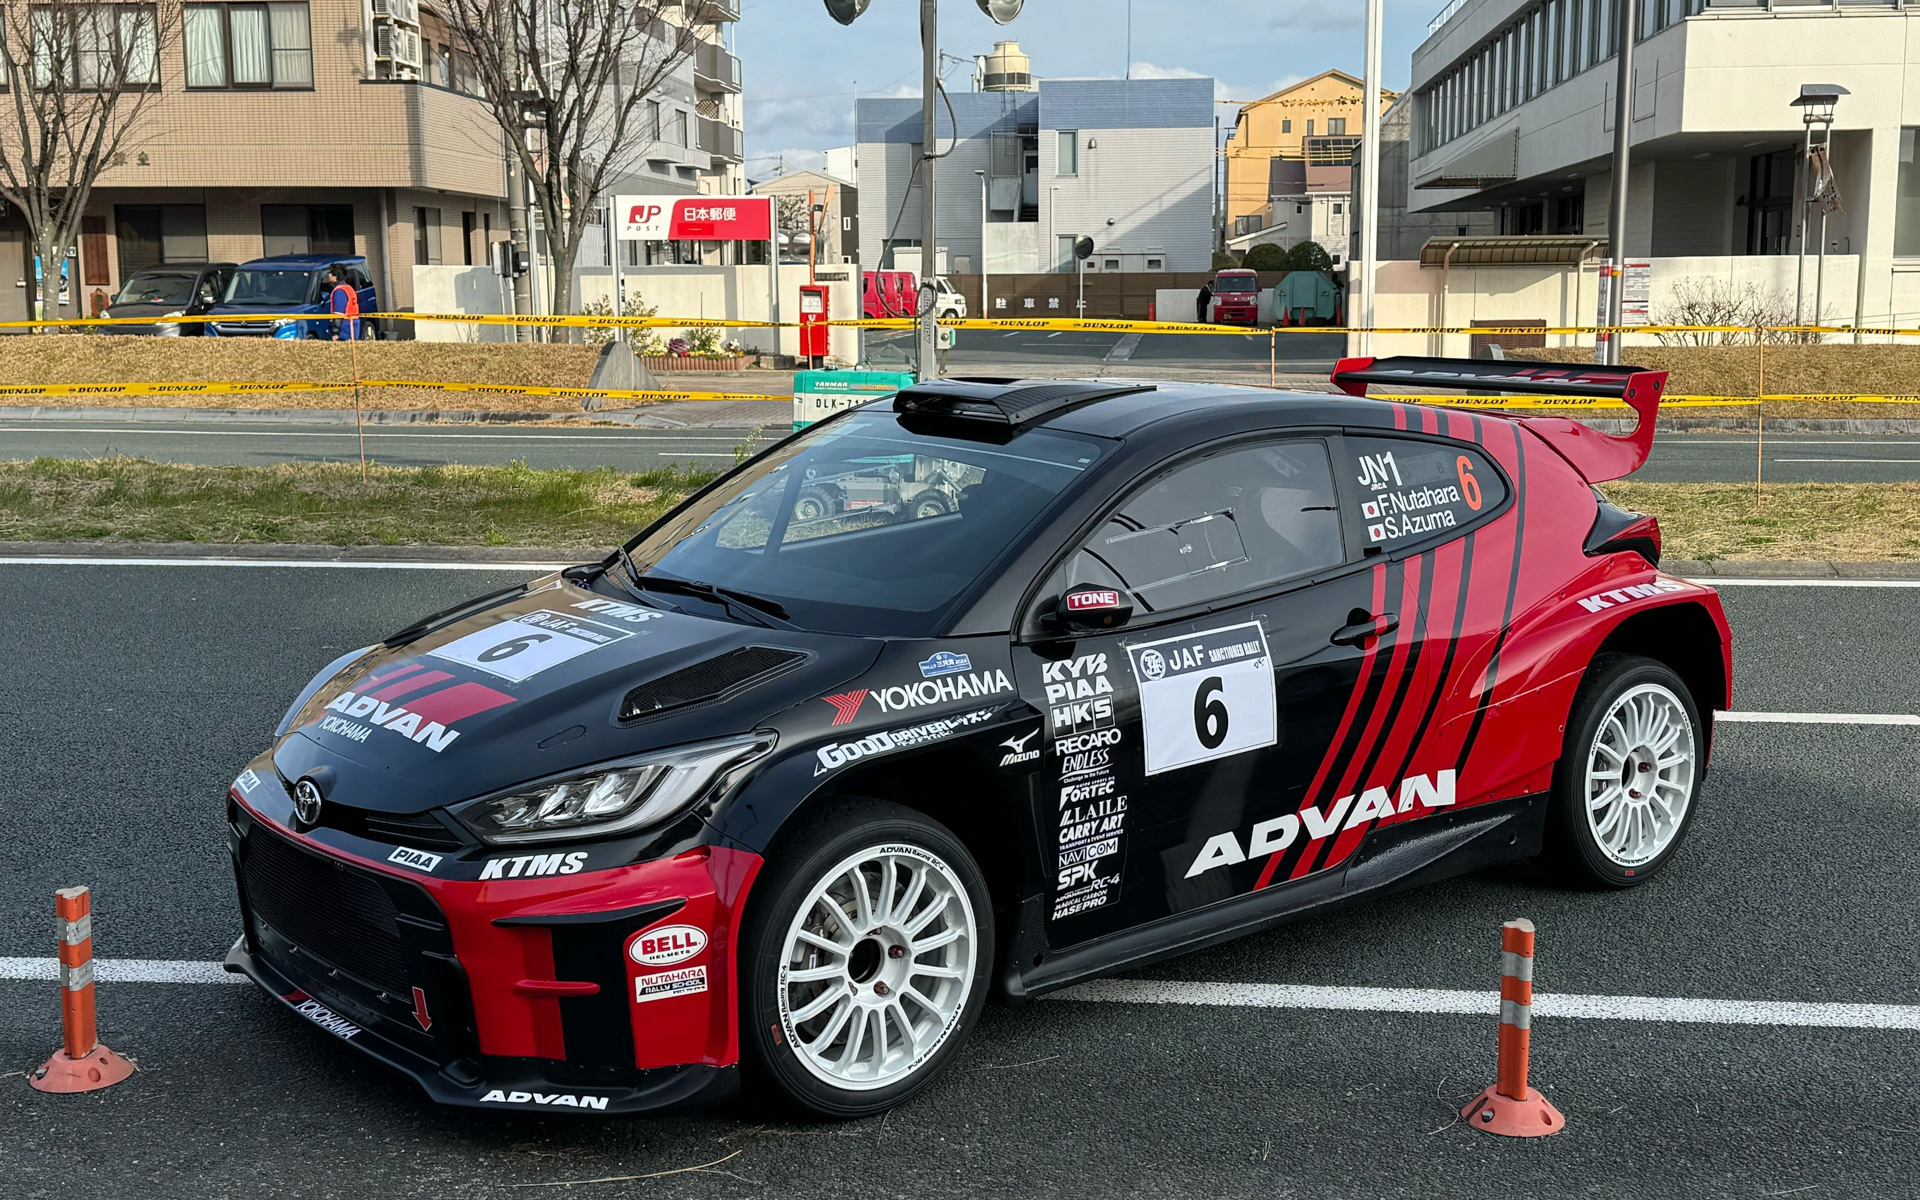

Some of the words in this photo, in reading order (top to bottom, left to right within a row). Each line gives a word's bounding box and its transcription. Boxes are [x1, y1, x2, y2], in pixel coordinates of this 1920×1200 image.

[629, 205, 662, 223] JP
[684, 207, 737, 222] 日本郵便
[996, 297, 1087, 309] 駐車禁止
[815, 381, 848, 389] YANMAR
[1357, 451, 1403, 487] JN1
[1456, 455, 1482, 511] 6
[1370, 482, 1388, 491] JRCA
[1377, 485, 1461, 516] F.Nutahara
[1384, 509, 1457, 539] S.Azuma
[569, 598, 664, 623] KTMS
[1071, 592, 1115, 607] TONE
[1577, 580, 1685, 613] KTMS
[539, 618, 579, 630] JAF
[477, 633, 553, 663] 6
[1169, 644, 1204, 671] JAF
[1208, 644, 1245, 663] SANCTIONED
[1243, 640, 1261, 656] RALLY
[1042, 652, 1108, 684] KYB
[870, 668, 1014, 713] YOKOHAMA
[1045, 675, 1114, 705] PIAA
[323, 691, 461, 753] ADVAN
[1052, 698, 1112, 728] HKS
[1193, 676, 1229, 750] 6
[318, 714, 373, 744] YOKOHAMA
[1055, 728, 1122, 756] RECARO
[816, 730, 896, 769] GOOD
[1061, 747, 1110, 774] ENDLESS
[1059, 780, 1115, 811] FORTEC
[1059, 819, 1100, 844] CARRY
[1099, 813, 1125, 833] ART
[1184, 768, 1456, 880] ADVAN
[879, 846, 912, 855] ADVAN
[1059, 838, 1087, 850] TRANSPORT
[1091, 833, 1106, 842] EVENT
[1106, 828, 1124, 838] SERVICE
[1059, 840, 1117, 867] NAVICOM
[393, 849, 435, 869] PIAA
[478, 851, 589, 880] KTMS
[1057, 860, 1099, 891] SPK
[1052, 896, 1107, 921] HASEPRO
[1055, 897, 1081, 911] MAGICAL
[1082, 888, 1108, 901] CARBON
[641, 932, 698, 955] BELL
[649, 949, 691, 961] HELMETS
[641, 968, 705, 987] NUTAHARA
[645, 984, 671, 994] RALLY
[672, 978, 703, 989] SCHOOL
[295, 999, 362, 1040] YOKOHAMA
[782, 1013, 801, 1049] ADVAN
[940, 1002, 962, 1039] ADVAN
[479, 1089, 609, 1110] ADVAN
